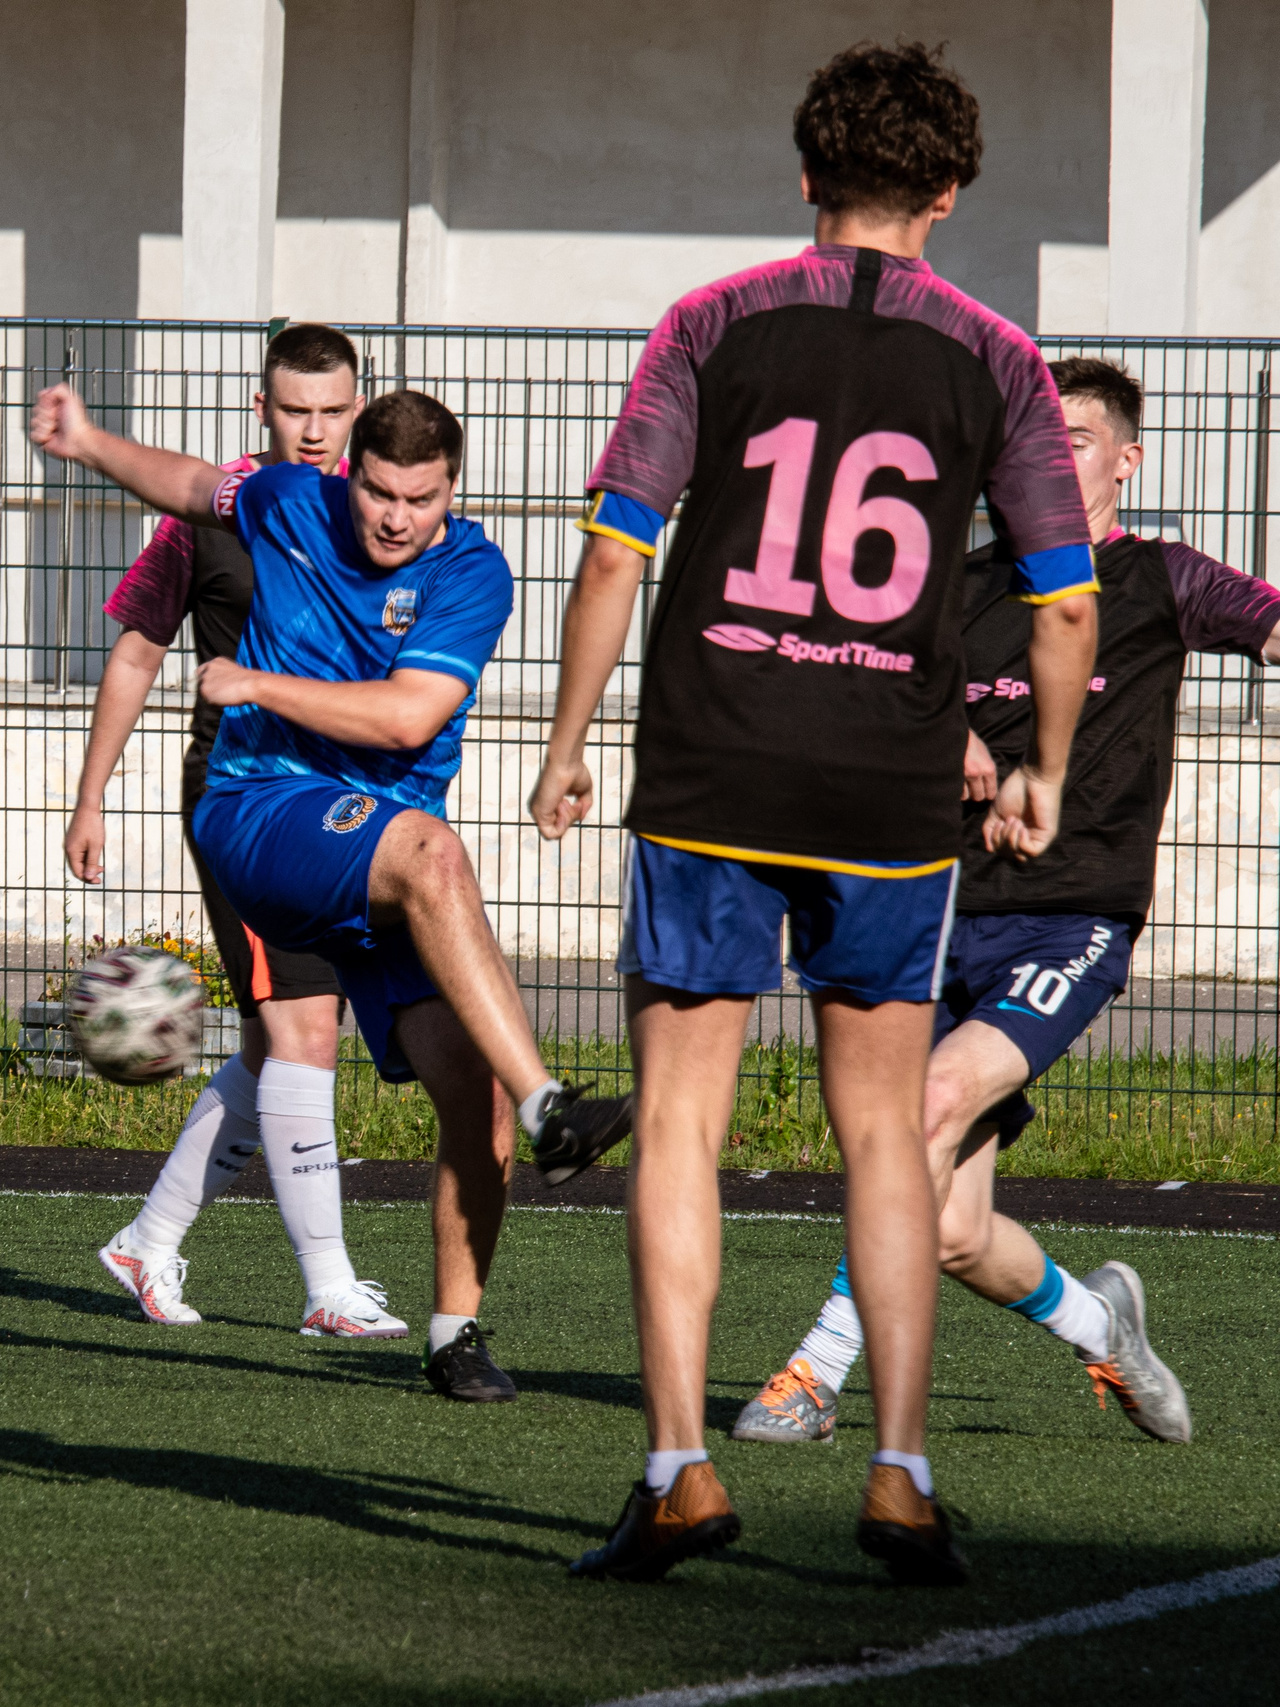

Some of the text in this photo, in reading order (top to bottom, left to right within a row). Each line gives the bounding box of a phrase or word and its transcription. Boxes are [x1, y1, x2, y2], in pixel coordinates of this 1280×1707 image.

[723, 416, 939, 624] 16
[776, 632, 915, 673] SportTime
[1007, 962, 1072, 1016] 10
